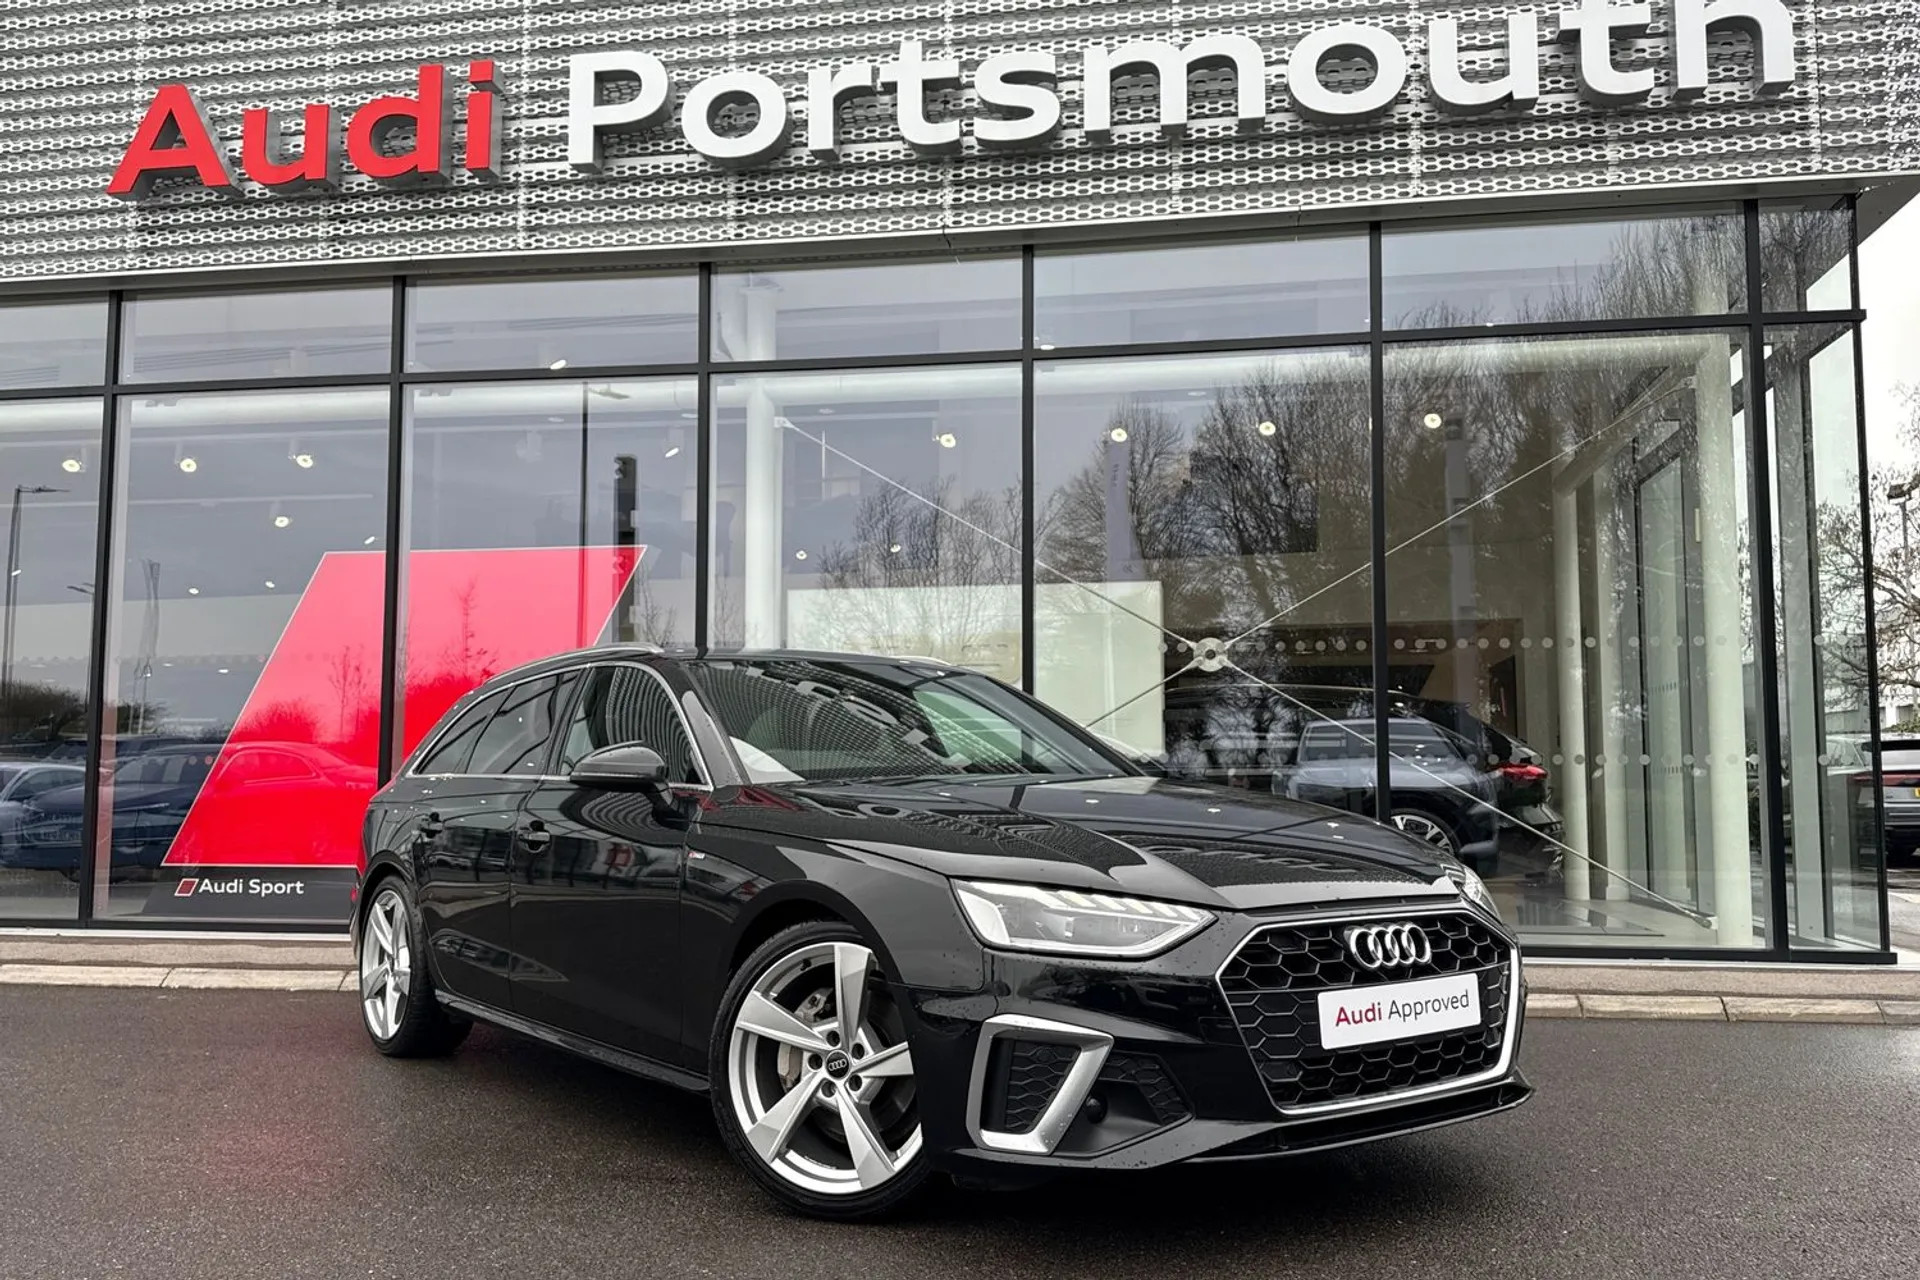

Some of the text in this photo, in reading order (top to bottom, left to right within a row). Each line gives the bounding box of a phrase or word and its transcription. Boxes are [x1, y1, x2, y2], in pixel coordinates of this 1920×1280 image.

[106, 0, 1797, 199] Audi Portsmouth
[199, 879, 305, 897] Audi Sport
[1335, 989, 1470, 1027] Audi Approved
